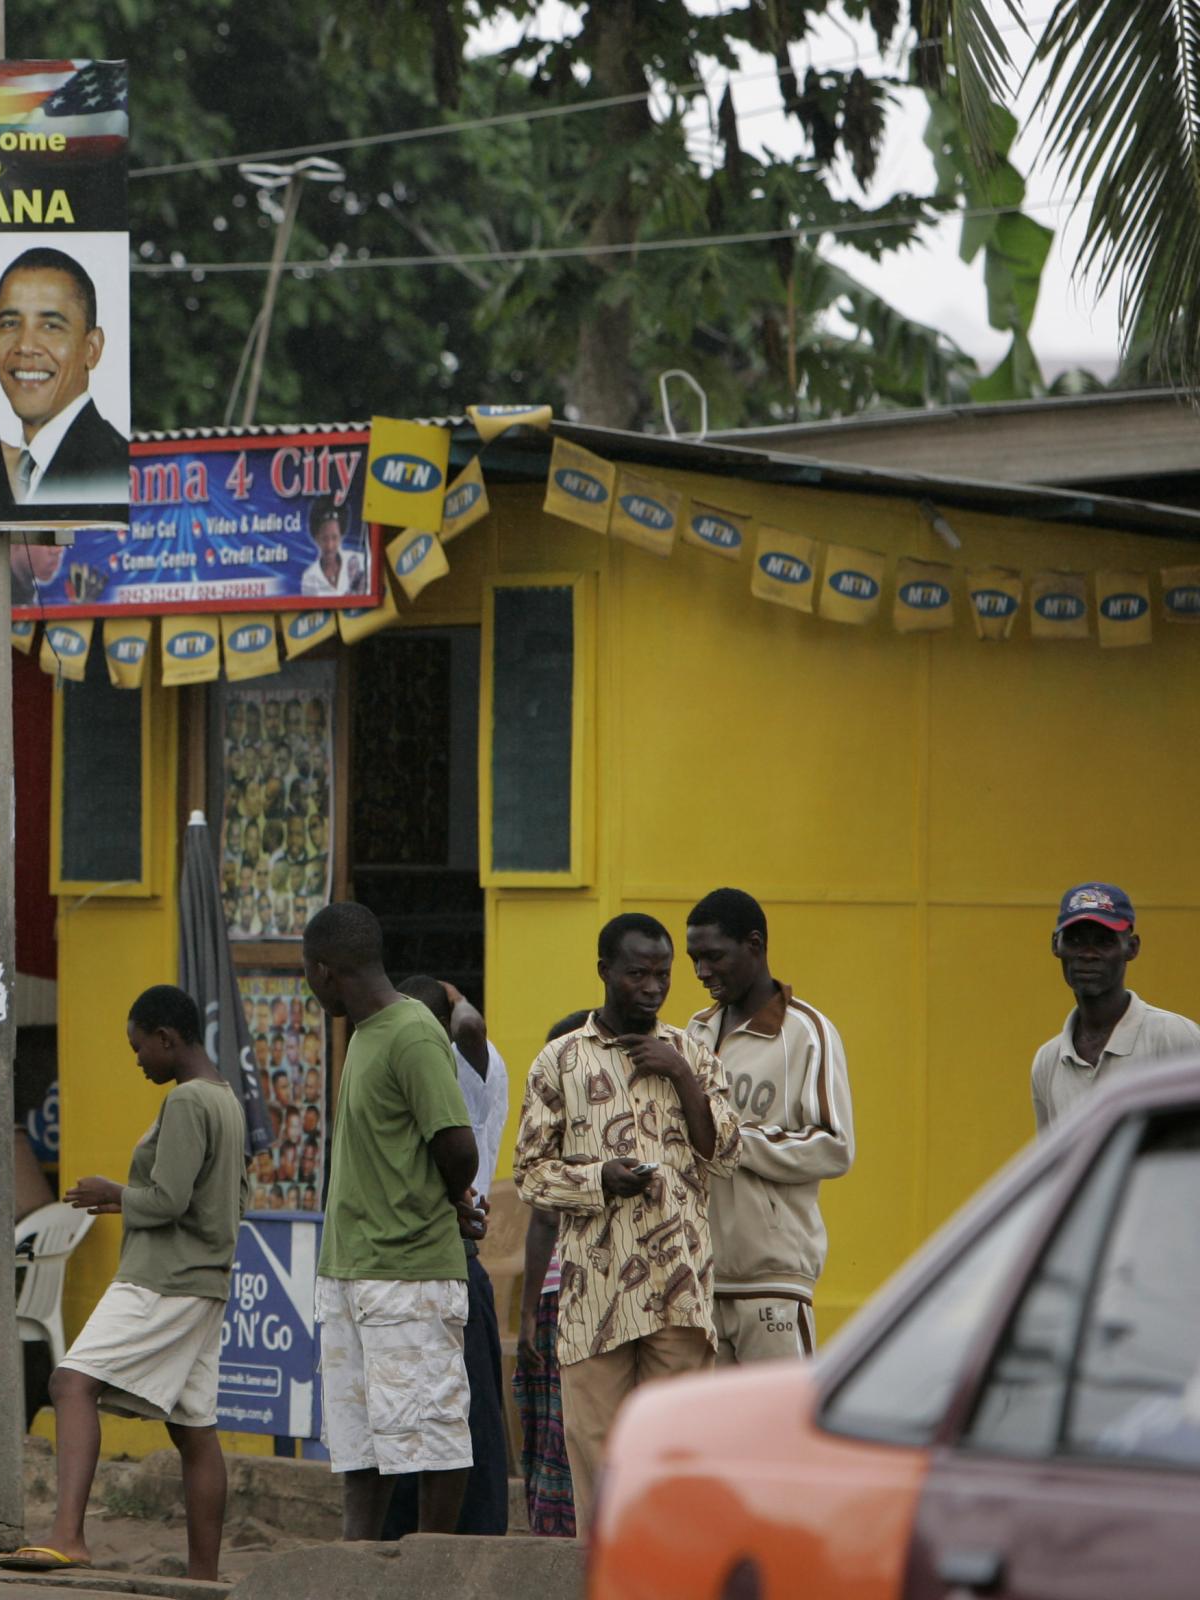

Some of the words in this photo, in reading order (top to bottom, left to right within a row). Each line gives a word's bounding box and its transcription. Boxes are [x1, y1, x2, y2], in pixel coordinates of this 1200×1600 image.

[225, 451, 253, 499] 4
[271, 446, 361, 506] City
[383, 460, 432, 487] MTN
[562, 473, 599, 499] MTN
[447, 486, 474, 514] MTN
[629, 499, 666, 526] MTN
[132, 524, 154, 541] Hair
[157, 520, 176, 538] Cut
[207, 518, 237, 535] Video
[241, 515, 249, 533] &
[252, 513, 282, 532] Audio
[700, 518, 734, 544] MTN
[162, 549, 197, 568] Centre
[221, 547, 254, 565] Credit
[257, 543, 288, 562] Cards
[402, 536, 426, 573] MTN
[766, 555, 803, 580] MTN
[839, 573, 872, 596] MTN
[908, 585, 942, 605] MTN
[976, 594, 1009, 613] MTN
[1044, 599, 1077, 615] MTN
[1109, 599, 1140, 616] MTN
[297, 610, 325, 635] MTN
[51, 629, 81, 652] MTN
[174, 636, 206, 655] MTN
[236, 627, 266, 649] MTN
[116, 642, 145, 659] MTN
[231, 1261, 268, 1311] igo
[759, 1306, 773, 1322] LE
[767, 1321, 793, 1333] COQ
